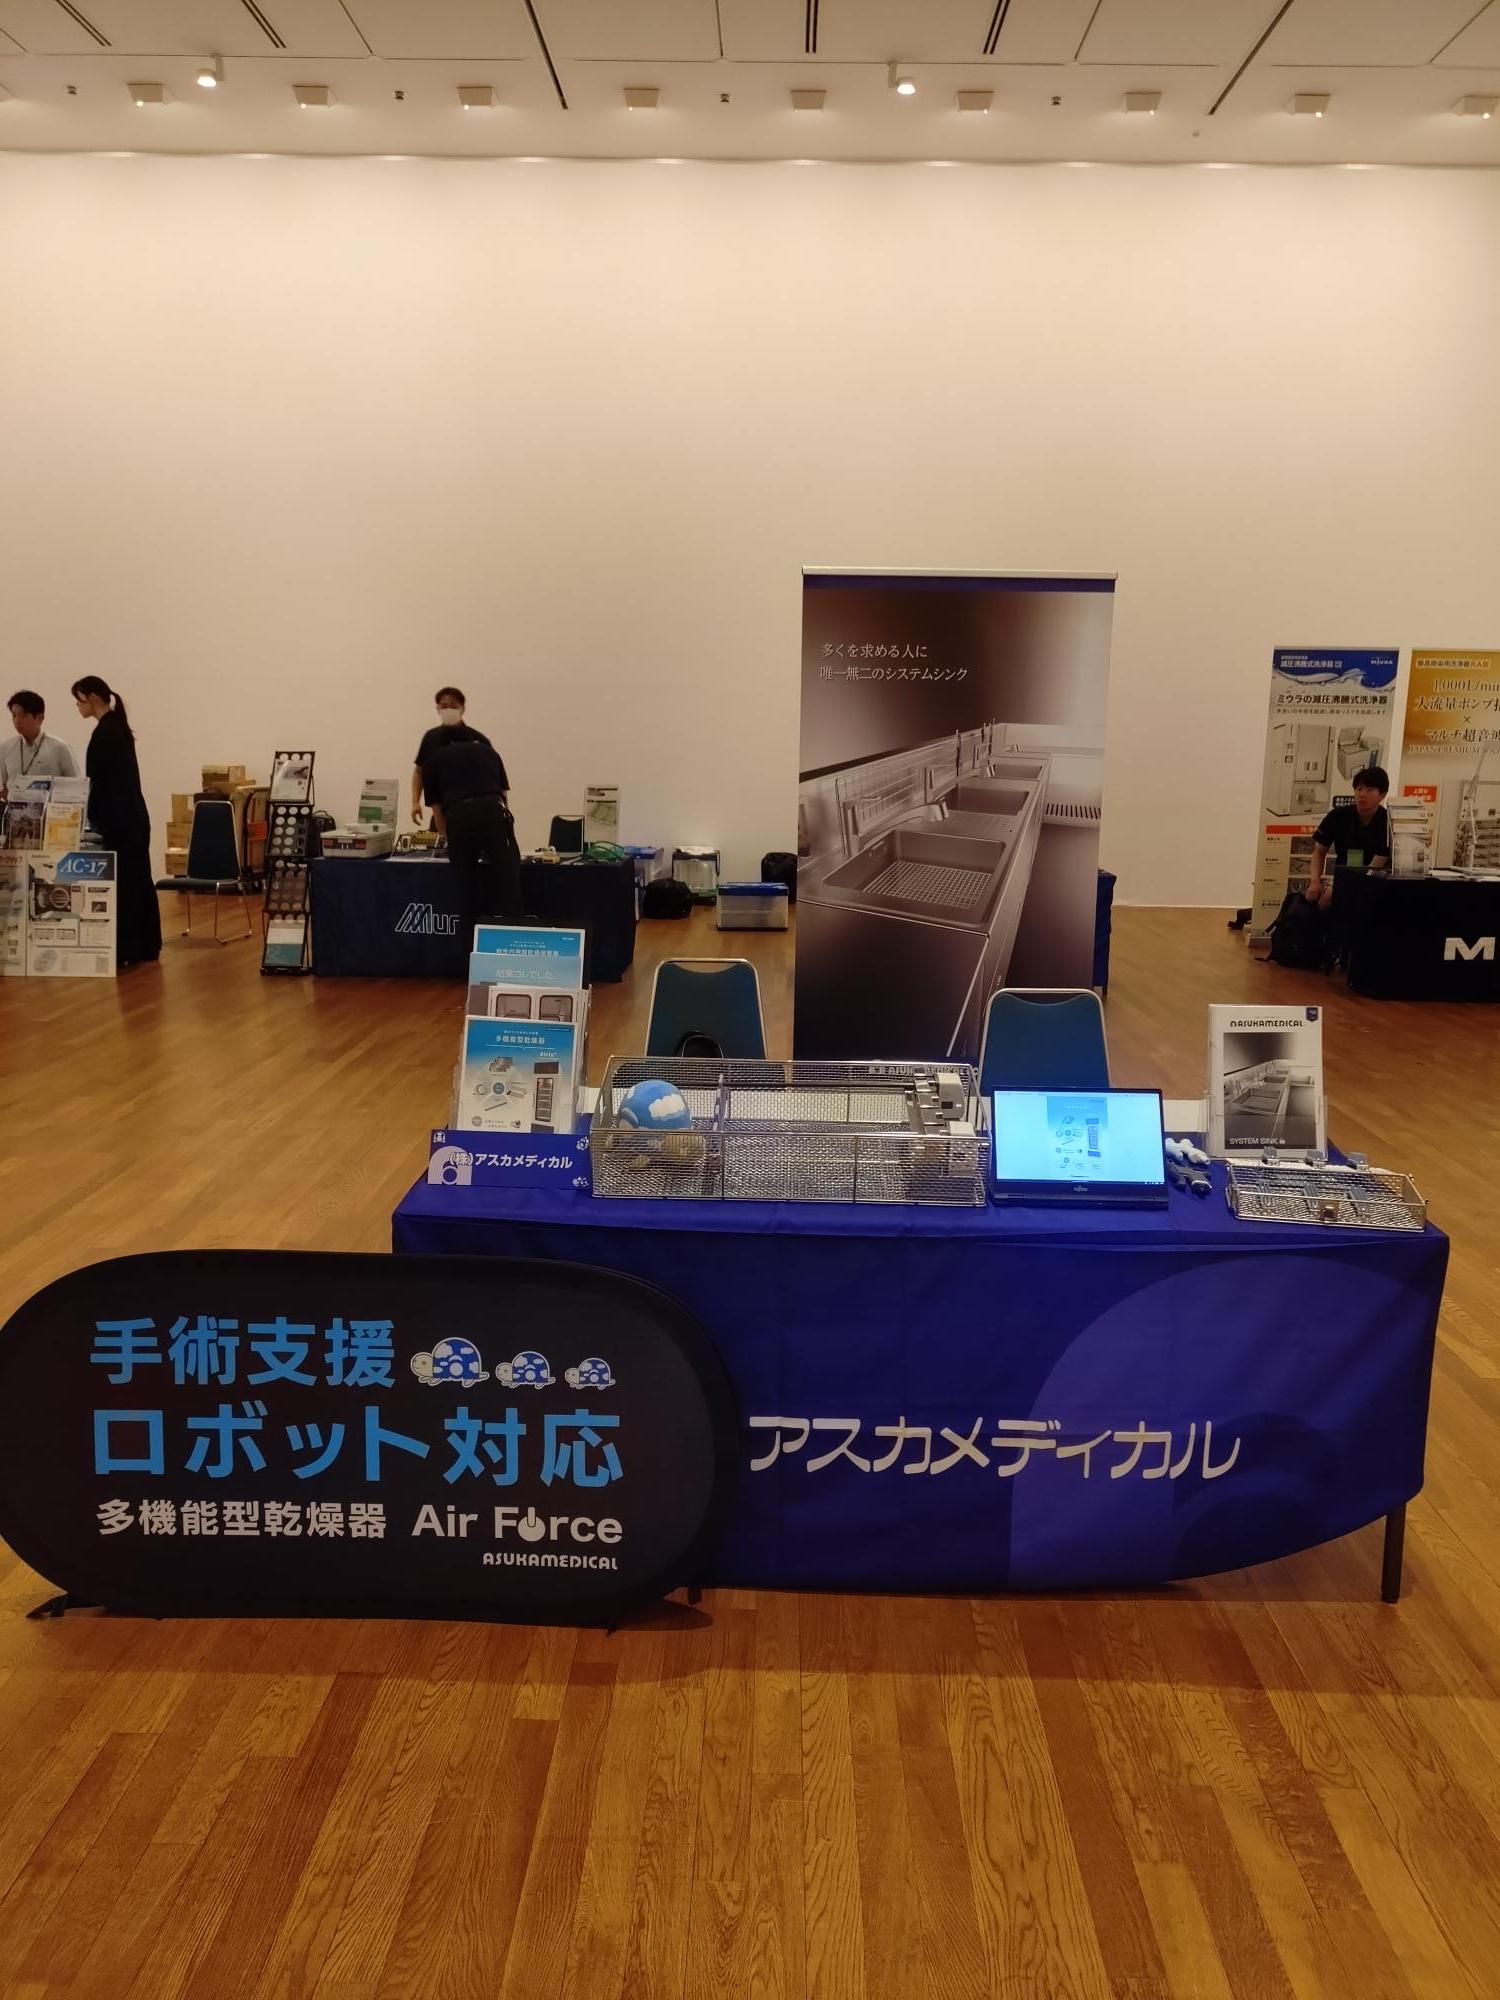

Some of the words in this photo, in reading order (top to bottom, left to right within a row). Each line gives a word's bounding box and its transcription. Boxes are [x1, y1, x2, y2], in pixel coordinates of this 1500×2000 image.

[822, 643, 928, 659] 多くを求める人に
[820, 666, 968, 681] 唯一無二のシステムシンク
[60, 858, 108, 877] AC-17
[1229, 1137, 1259, 1145] SYSTEM
[1260, 1137, 1279, 1145] SINK
[89, 1315, 396, 1389] 手術支援
[93, 1399, 624, 1488] ロボット対応
[749, 1416, 1241, 1480] アスカメディカル
[96, 1498, 387, 1540] 多機能型乾燥器
[411, 1503, 478, 1538] Air
[495, 1506, 623, 1544] Force
